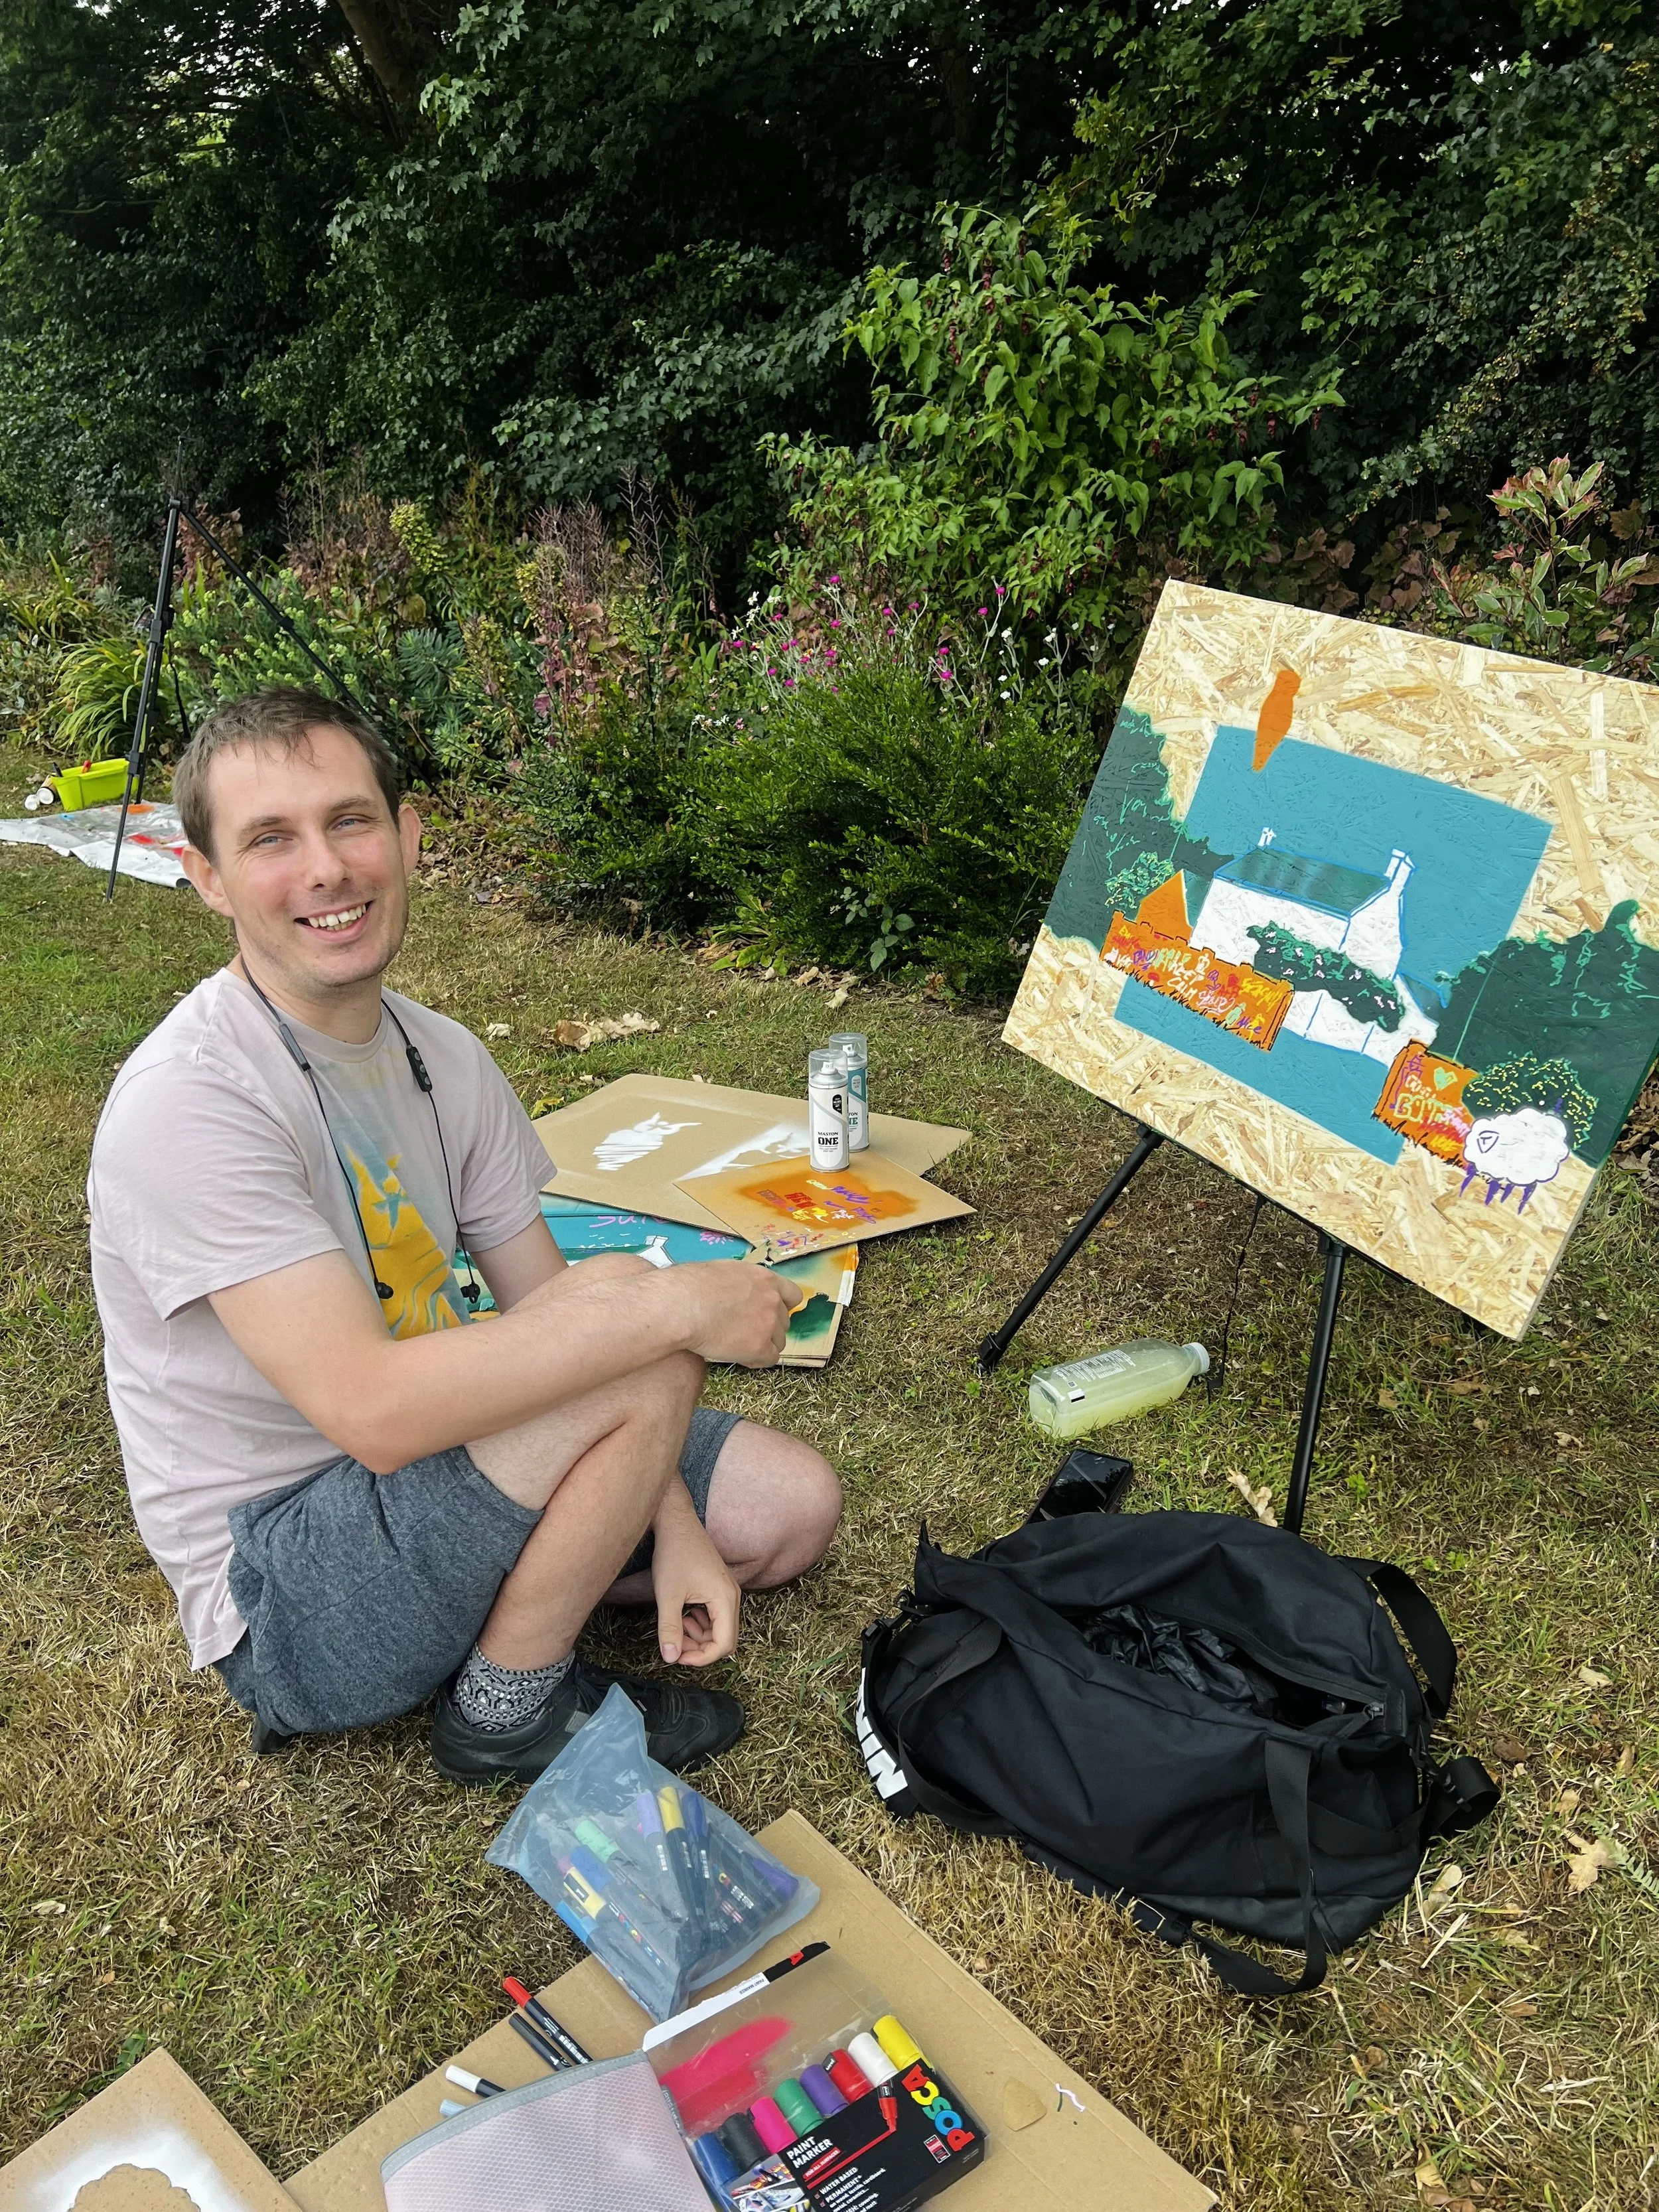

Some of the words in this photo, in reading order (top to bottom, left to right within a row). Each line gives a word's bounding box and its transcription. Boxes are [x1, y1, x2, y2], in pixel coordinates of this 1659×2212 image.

[818, 1137, 839, 1145] ONE
[901, 2064, 975, 2152] POSCA
[786, 2136, 816, 2160] PAINT
[792, 2138, 833, 2169] MARKER
[820, 2150, 839, 2168] SURFACES
[819, 2178, 841, 2195] WATER
[839, 2167, 859, 2182] BASED
